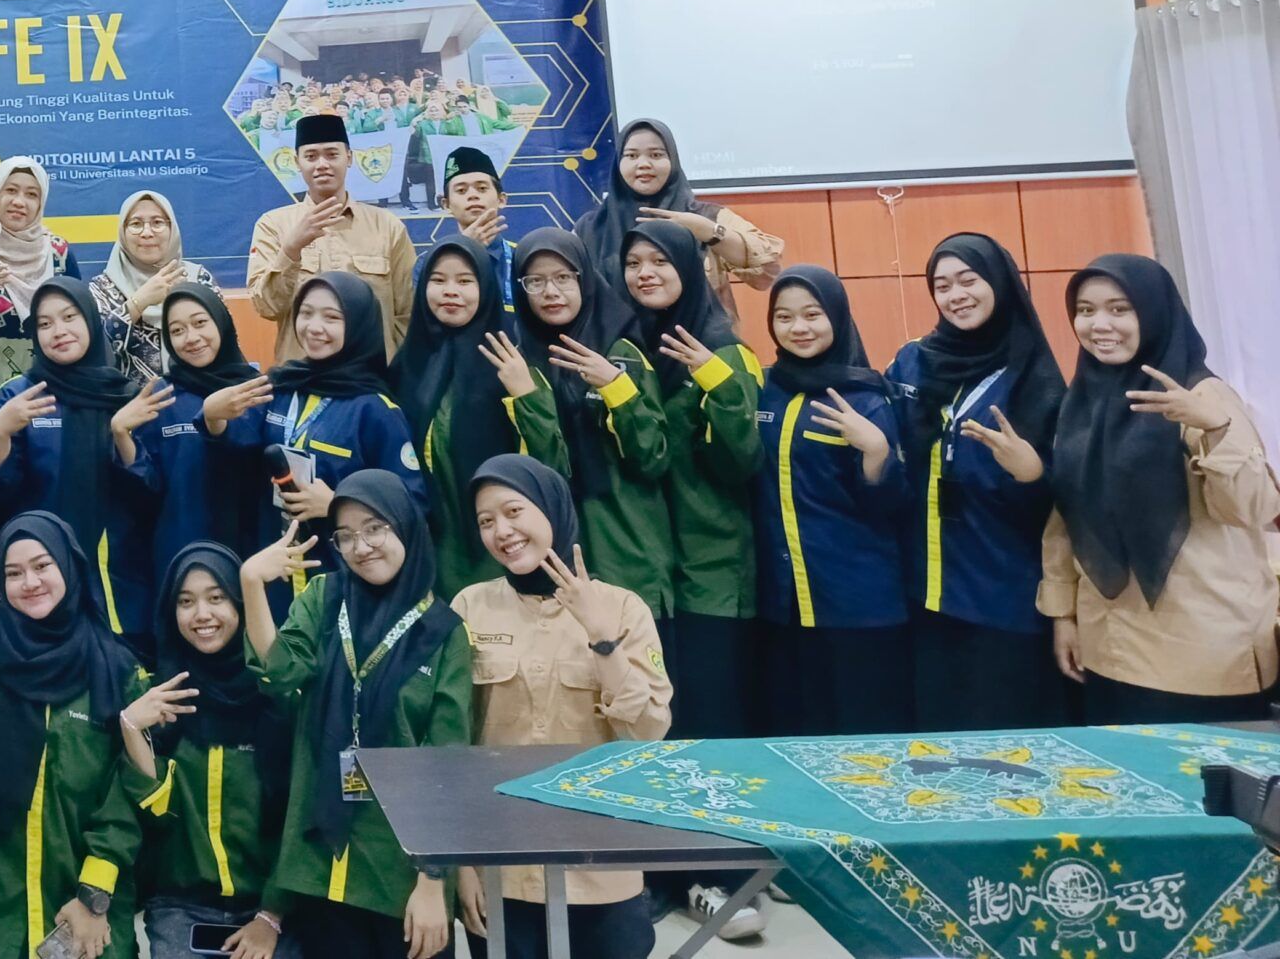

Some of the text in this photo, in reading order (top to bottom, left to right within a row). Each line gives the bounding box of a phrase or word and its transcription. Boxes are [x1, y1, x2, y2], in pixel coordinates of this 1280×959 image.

[67, 13, 128, 83] IX
[26, 94, 70, 108] Tinggi
[73, 92, 130, 105] Kualitas
[133, 89, 175, 102] Untuk
[59, 110, 94, 123] Yang
[98, 106, 193, 121] Berintegritas.
[29, 148, 196, 166] DITORIUM LANTAI 5
[70, 167, 135, 180] Universitas
[138, 167, 156, 177] NU
[159, 164, 208, 177] Sidoarjo
[1018, 931, 1136, 957] N U
